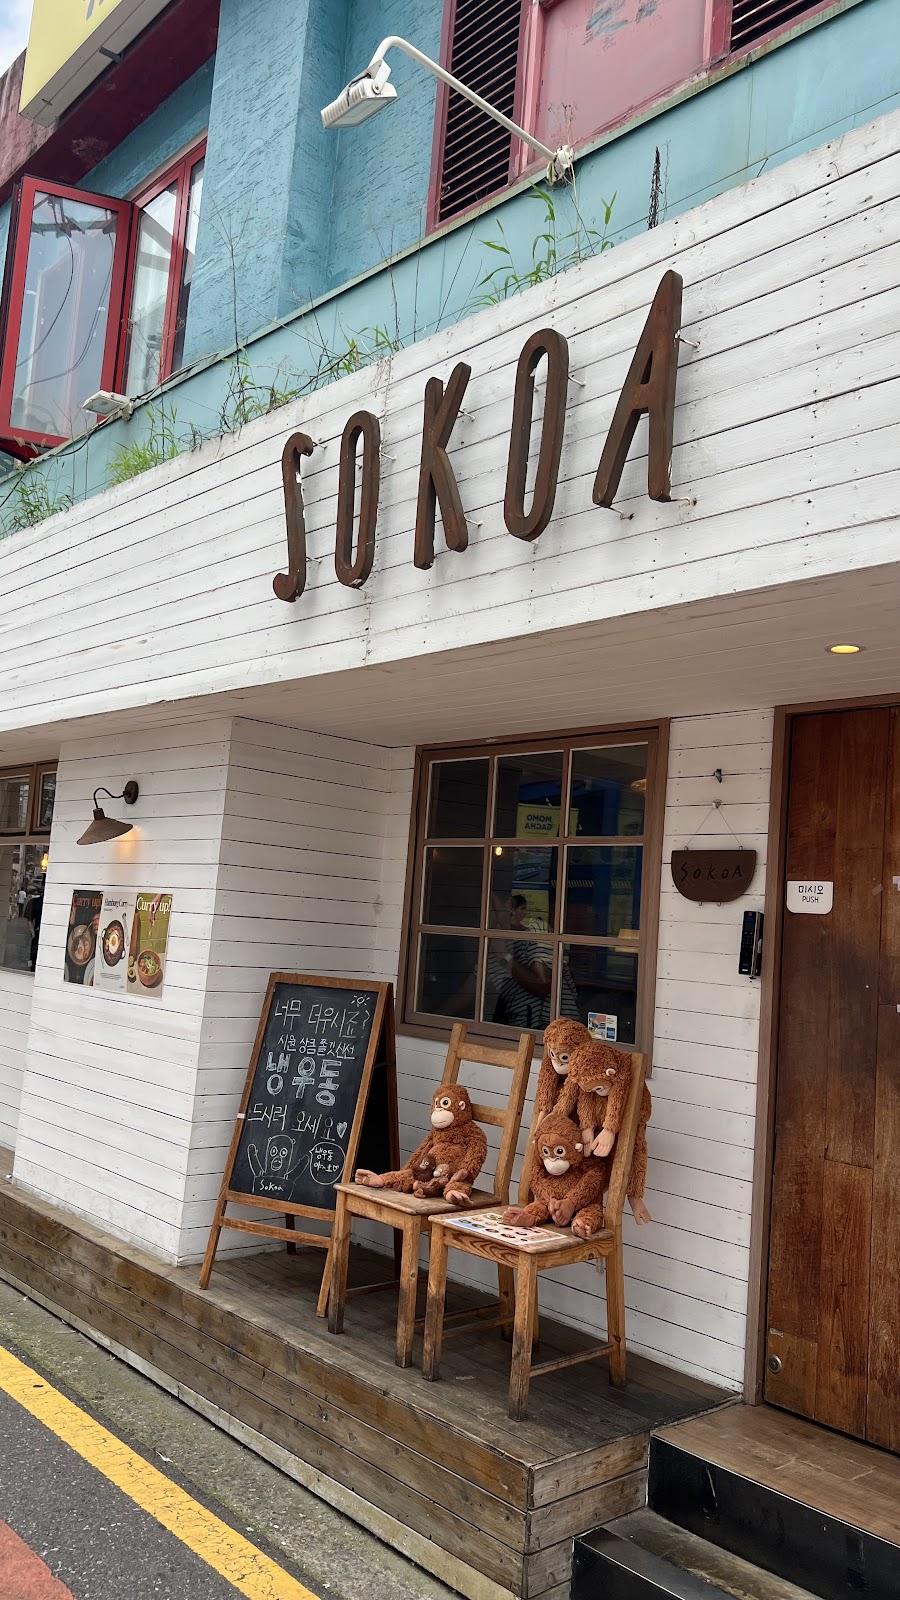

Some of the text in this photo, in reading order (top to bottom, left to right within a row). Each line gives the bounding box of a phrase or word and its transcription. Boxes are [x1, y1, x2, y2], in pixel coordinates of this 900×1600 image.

[272, 269, 684, 603] SOKOA
[798, 885, 825, 895] 미시오
[801, 895, 819, 904] PUSH
[136, 897, 171, 914] Curry up!
[275, 999, 370, 1039] 너무 더우시죠?
[278, 1033, 296, 1051] 시원
[299, 1037, 316, 1055] 상큼
[336, 1041, 355, 1060] 신선
[266, 1051, 342, 1106] 냉우동
[248, 1103, 336, 1142] 드시러 오세요
[315, 1147, 333, 1162] 냉우동
